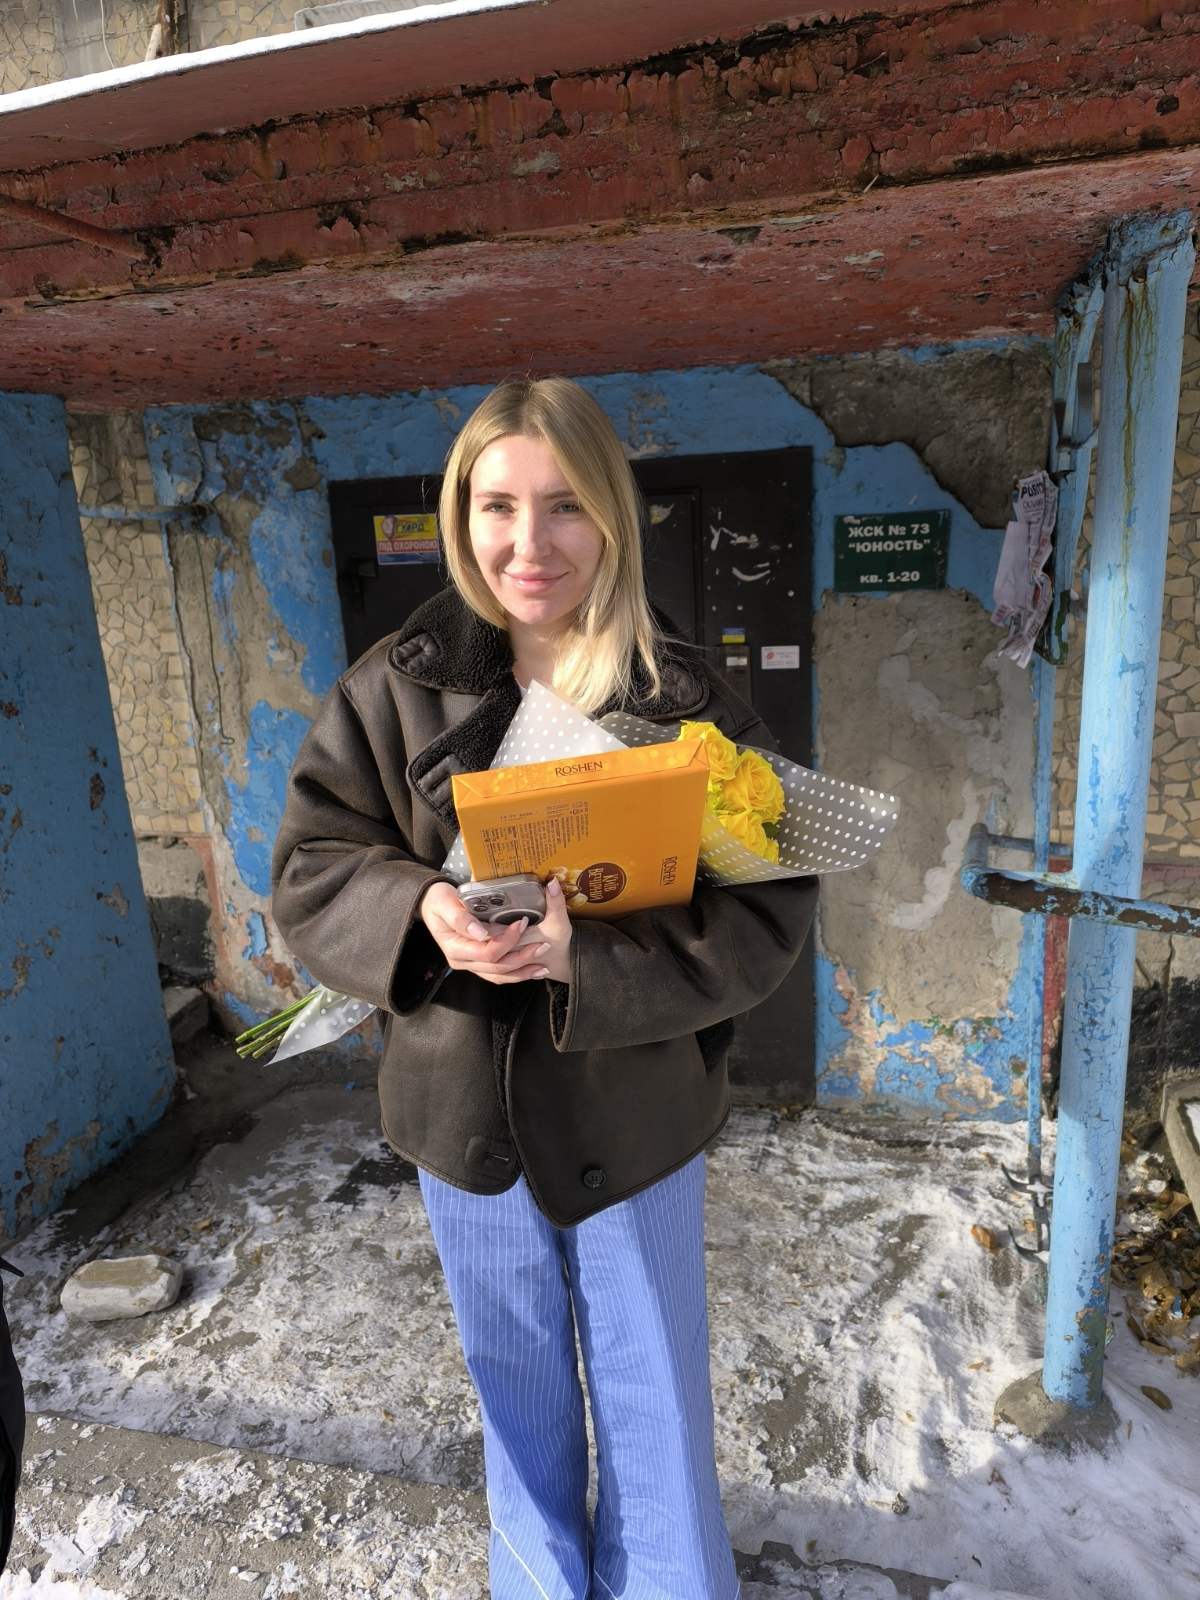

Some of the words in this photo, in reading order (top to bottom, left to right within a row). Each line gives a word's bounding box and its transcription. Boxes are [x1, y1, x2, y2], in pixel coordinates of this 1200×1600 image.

[848, 525, 884, 538] ЖСК
[888, 524, 907, 536] №
[910, 523, 930, 535] 73
[887, 571, 920, 582] 1-20
[555, 760, 603, 776] ROSHEN
[661, 856, 678, 886] ROSHEN
